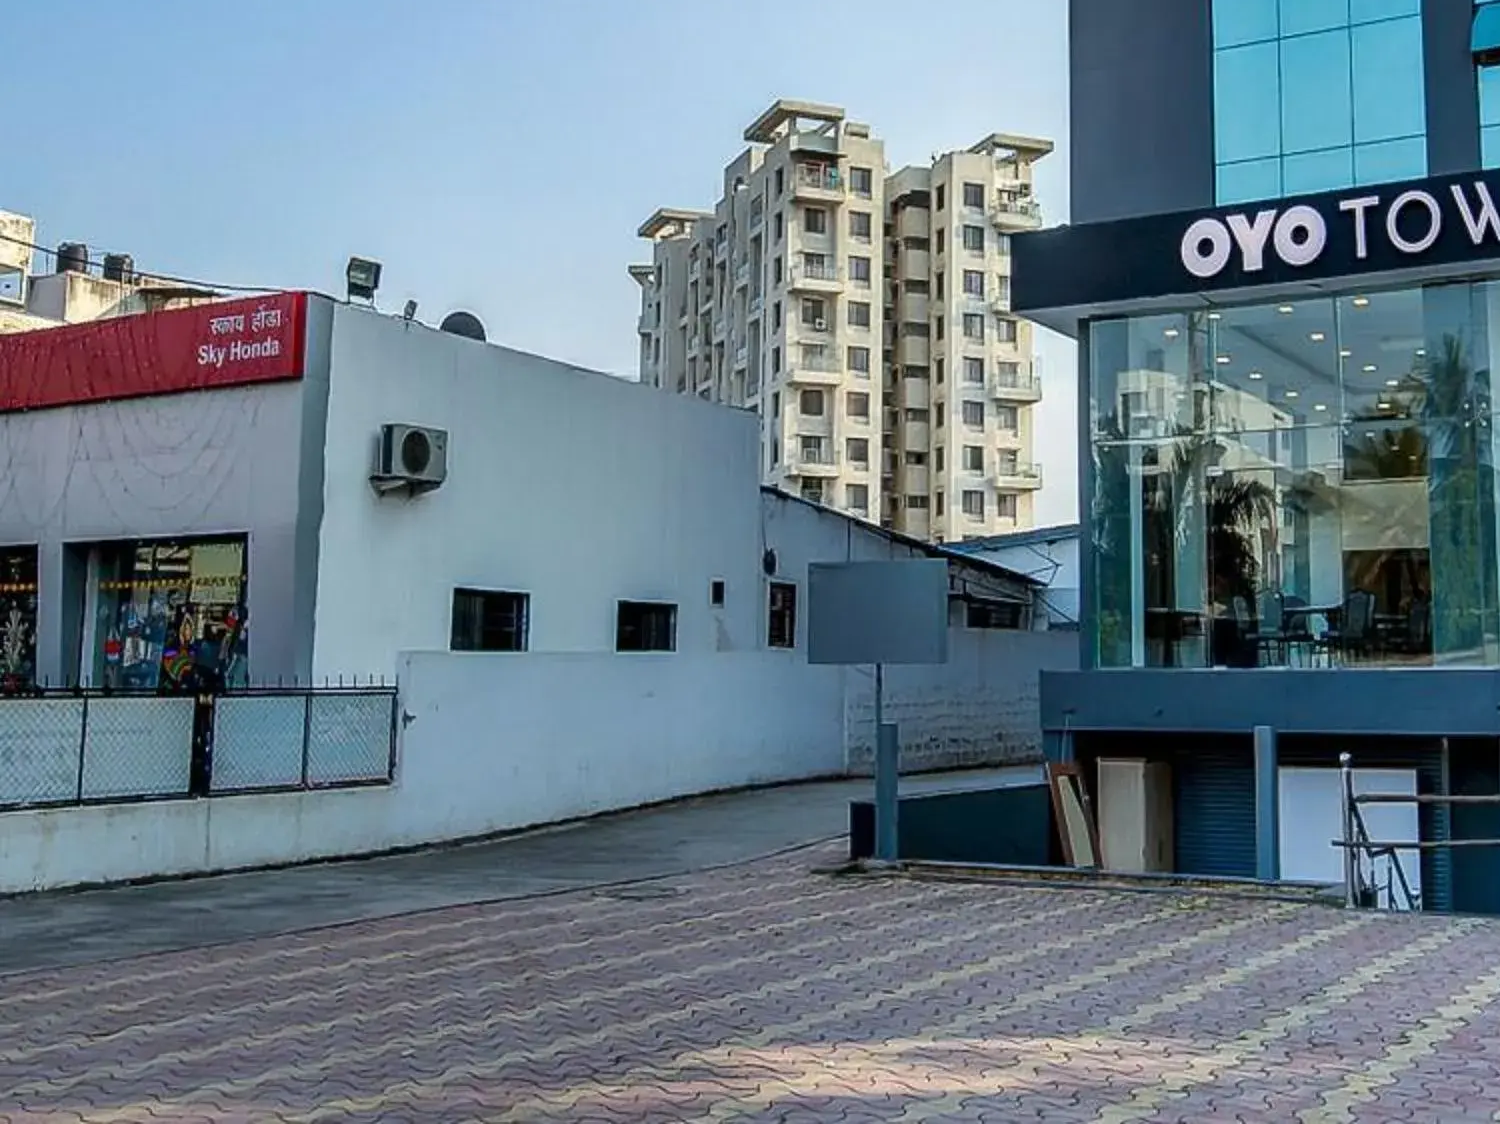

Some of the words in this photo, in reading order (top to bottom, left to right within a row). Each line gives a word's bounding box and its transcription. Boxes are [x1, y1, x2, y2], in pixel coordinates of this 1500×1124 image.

[1181, 205, 1327, 278] OYO
[197, 344, 226, 367] Sky
[229, 336, 280, 361] Honda
